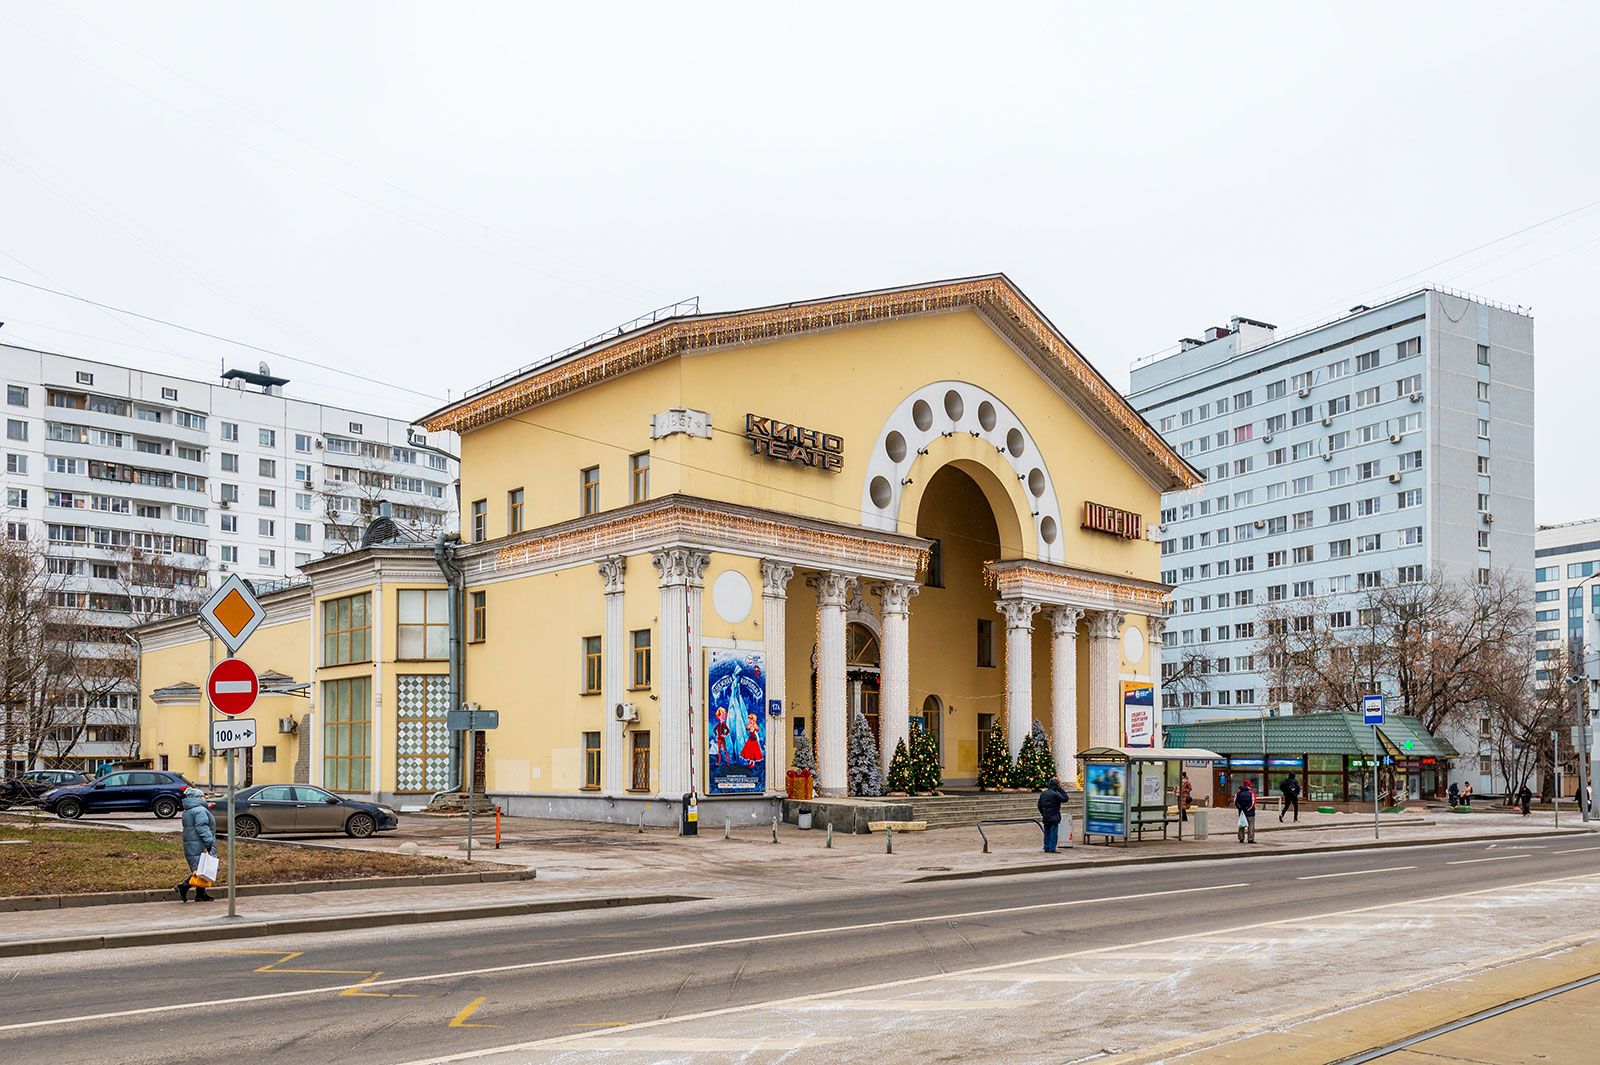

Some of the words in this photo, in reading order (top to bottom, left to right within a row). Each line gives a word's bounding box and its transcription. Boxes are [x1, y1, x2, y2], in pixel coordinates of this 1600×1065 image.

[745, 433, 844, 468] ТЕАТР
[746, 413, 844, 454] КИНО
[1084, 501, 1142, 540] ПОБЕДА
[216, 730, 233, 742] 100
